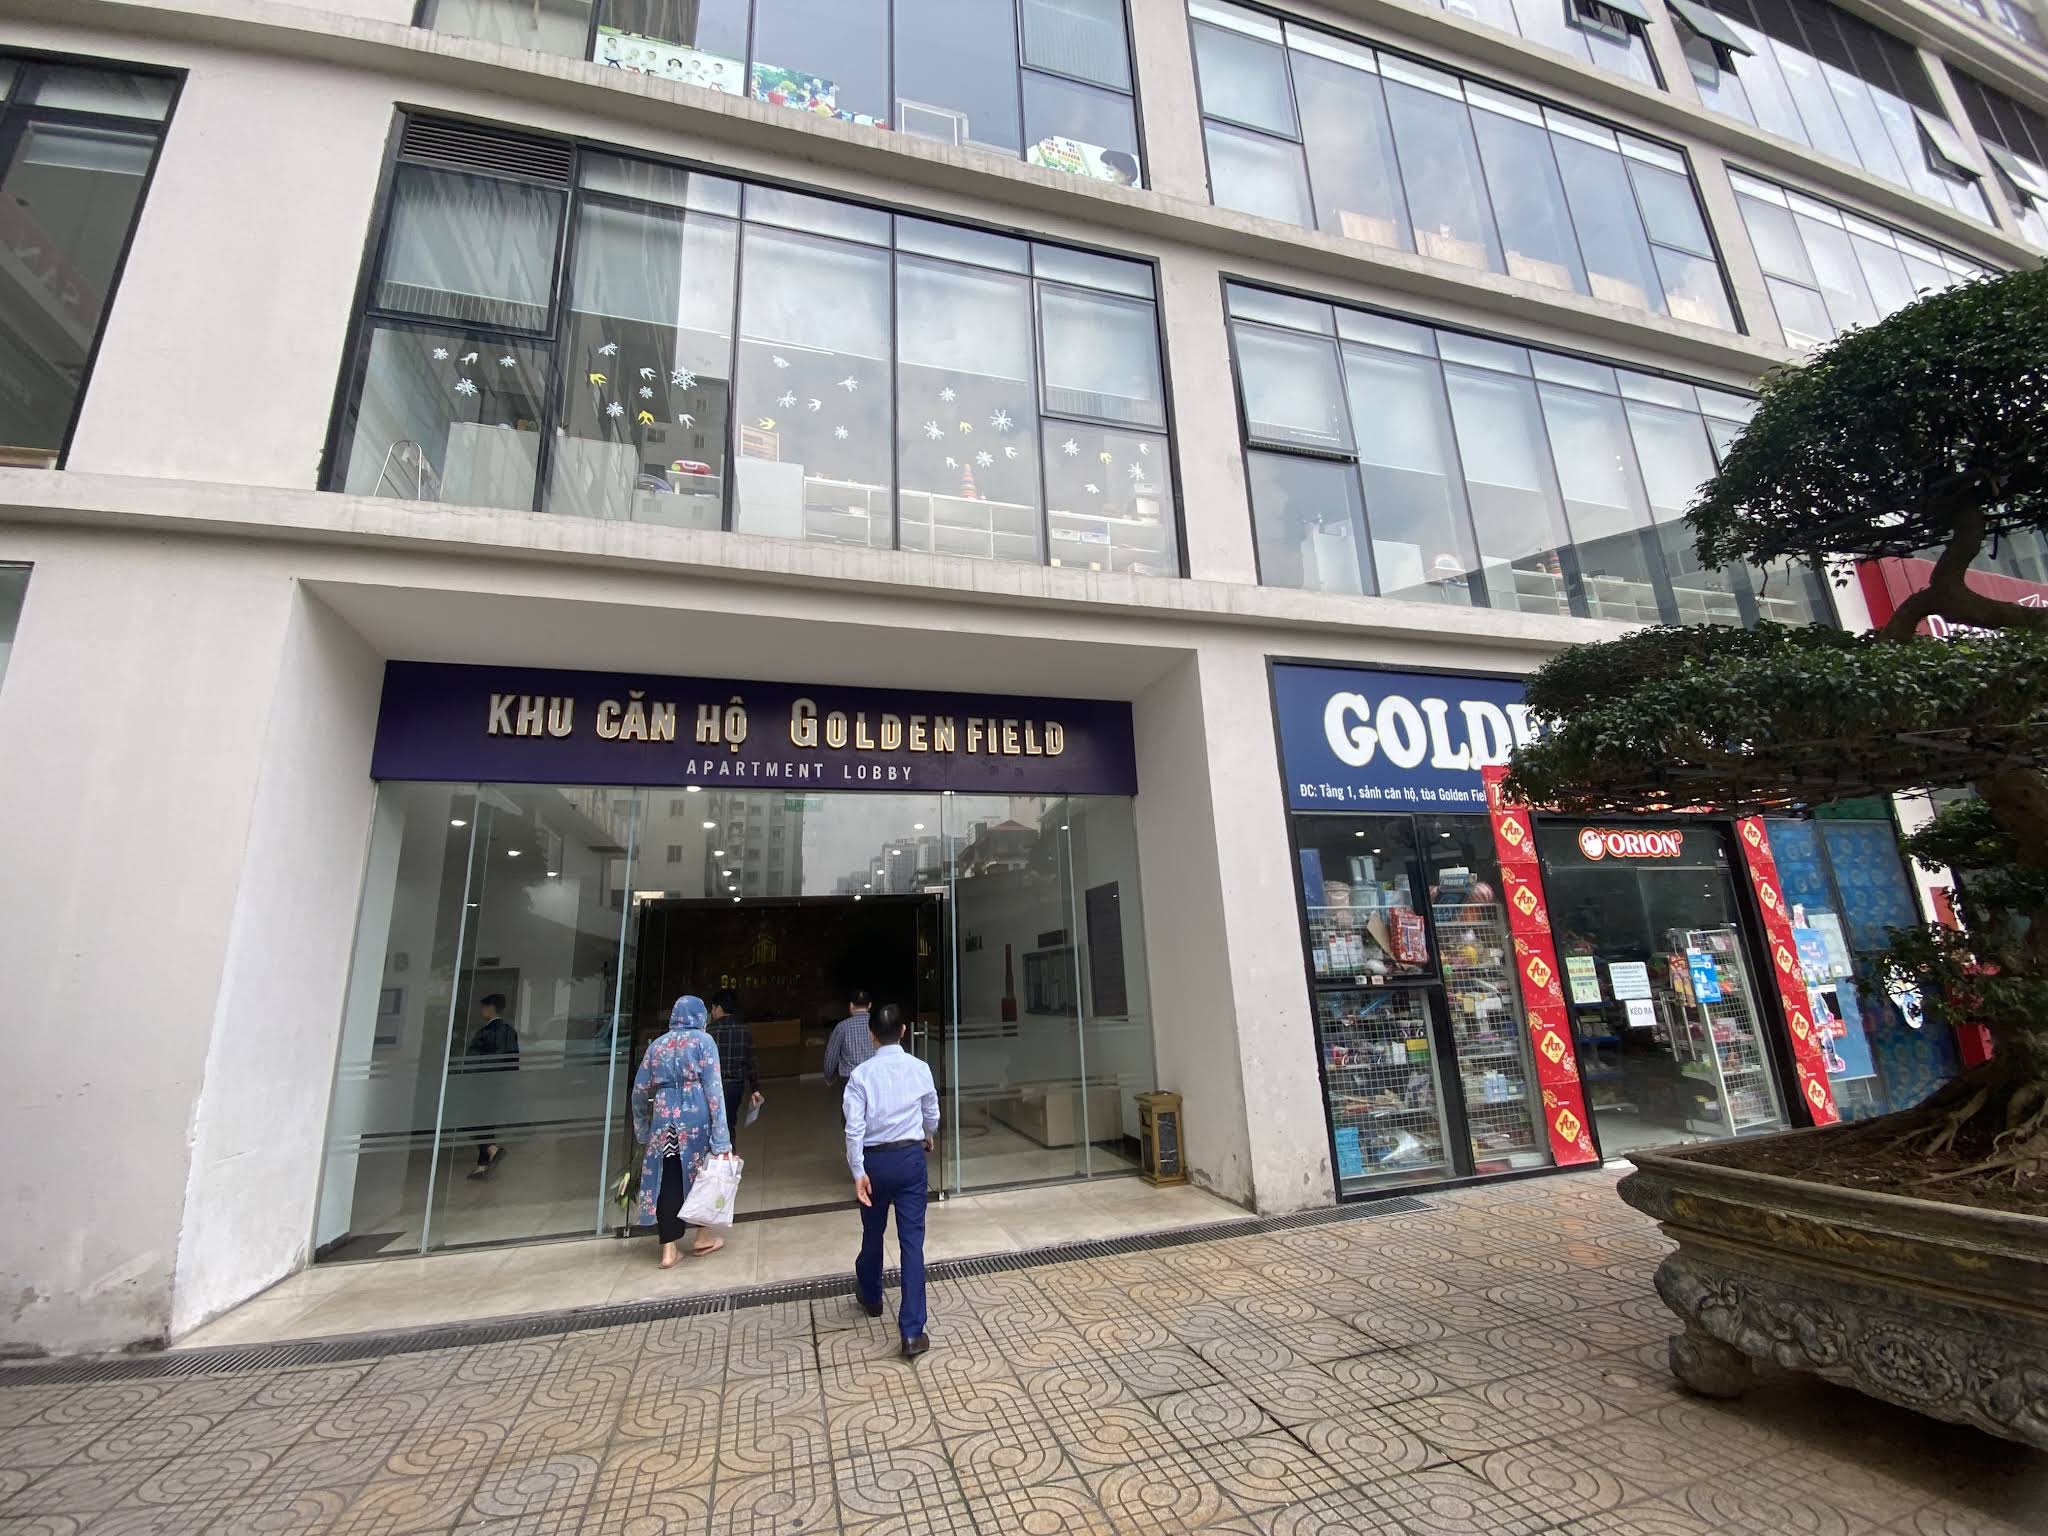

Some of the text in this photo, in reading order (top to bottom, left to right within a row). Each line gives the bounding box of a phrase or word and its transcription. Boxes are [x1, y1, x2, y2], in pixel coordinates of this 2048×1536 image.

[488, 689, 1064, 755] KHU CĂN HỘ GOLDEN FIELD
[1324, 691, 1562, 771] GOLDE
[686, 759, 912, 780] APARTMENT LOBBY
[1300, 784, 1317, 797] ĐC:
[1321, 782, 1344, 800] Tầng
[1347, 786, 1356, 799] 1,
[1359, 785, 1382, 799] sảnh
[1384, 788, 1402, 799] căn
[1404, 787, 1419, 802] hộ,
[1421, 787, 1436, 801] tòa
[1438, 788, 1469, 801] Golden
[1472, 789, 1487, 802] Fiel
[1607, 832, 1678, 856] ORION
